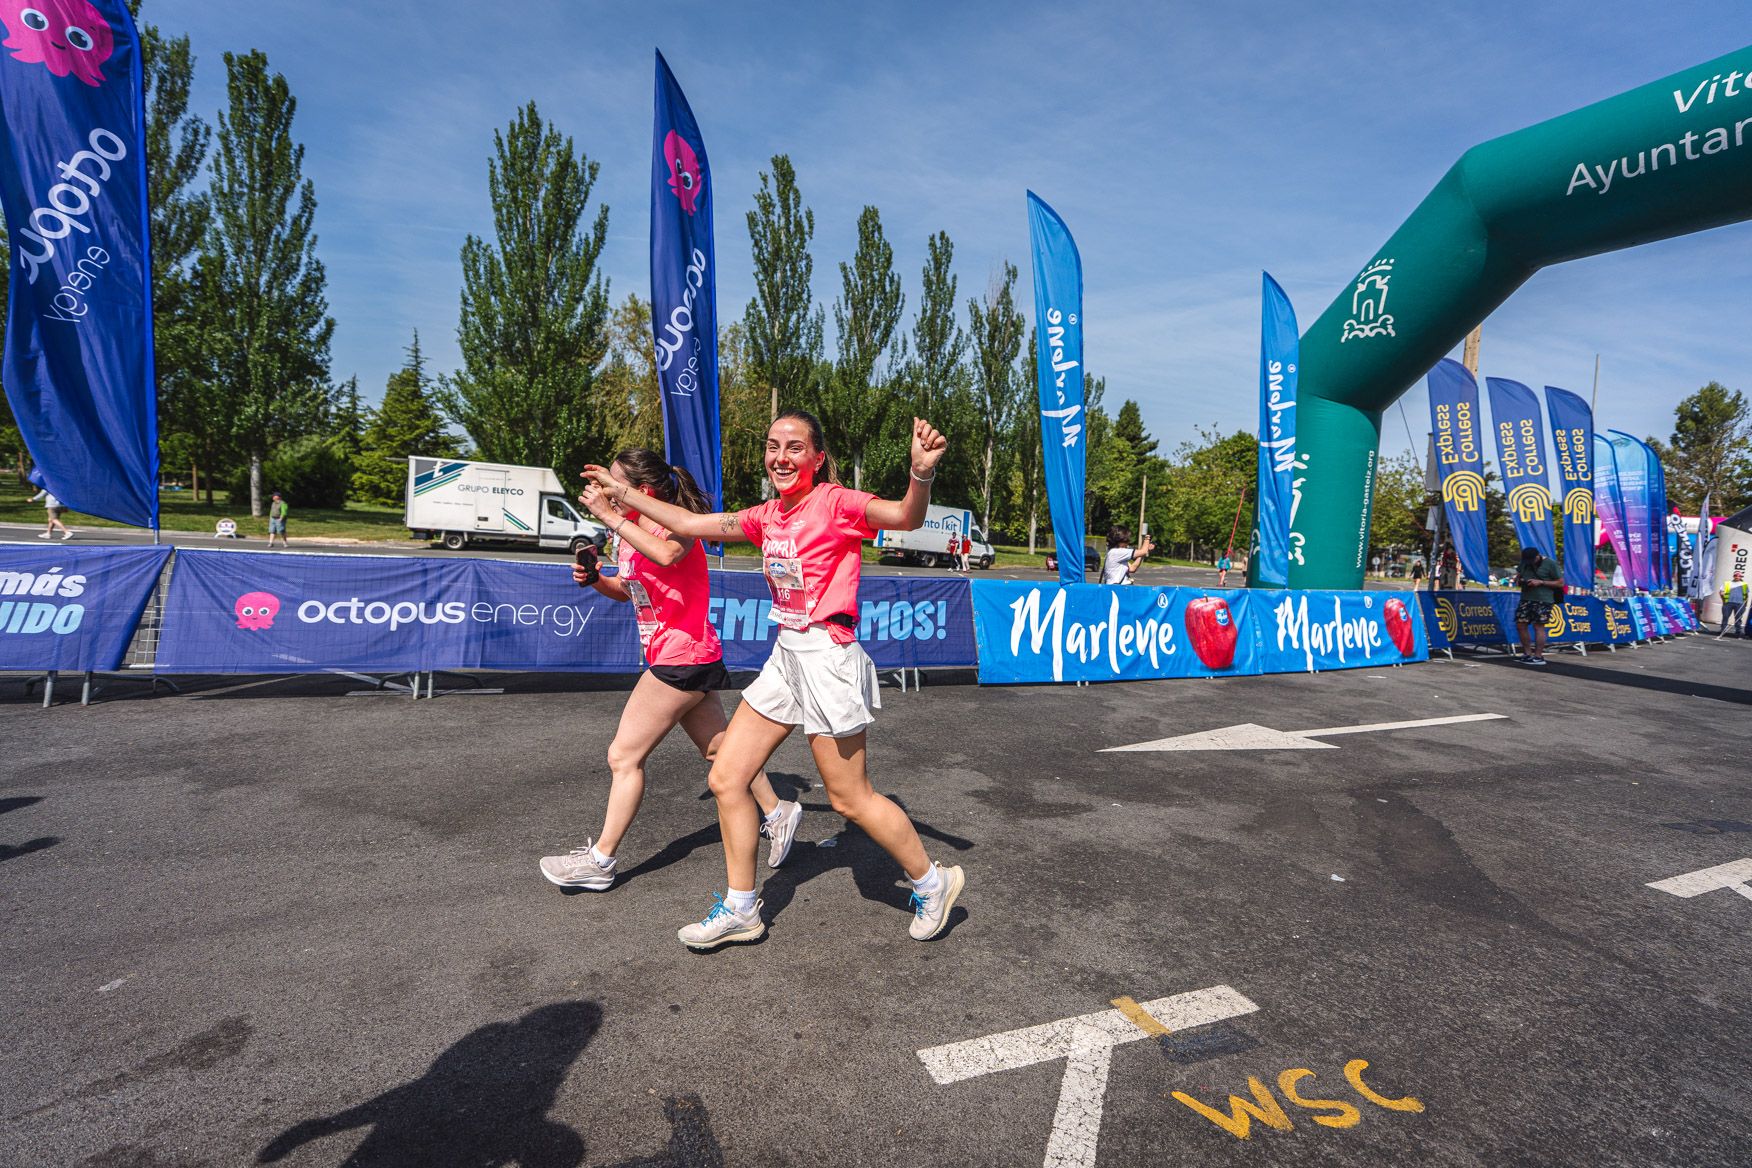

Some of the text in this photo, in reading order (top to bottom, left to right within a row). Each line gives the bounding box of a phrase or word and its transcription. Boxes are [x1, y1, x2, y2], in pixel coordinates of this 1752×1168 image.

[457, 484, 524, 496] GRUPO ELEYCO
[1356, 450, 1375, 568] www.vitoria-gasteiz.org
[924, 519, 940, 529] nto
[297, 597, 595, 637] octopus energy
[1460, 603, 1493, 617] Correos
[1010, 587, 1176, 681] Marlene
[1273, 595, 1381, 671] Marlene
[1462, 621, 1496, 638] Express
